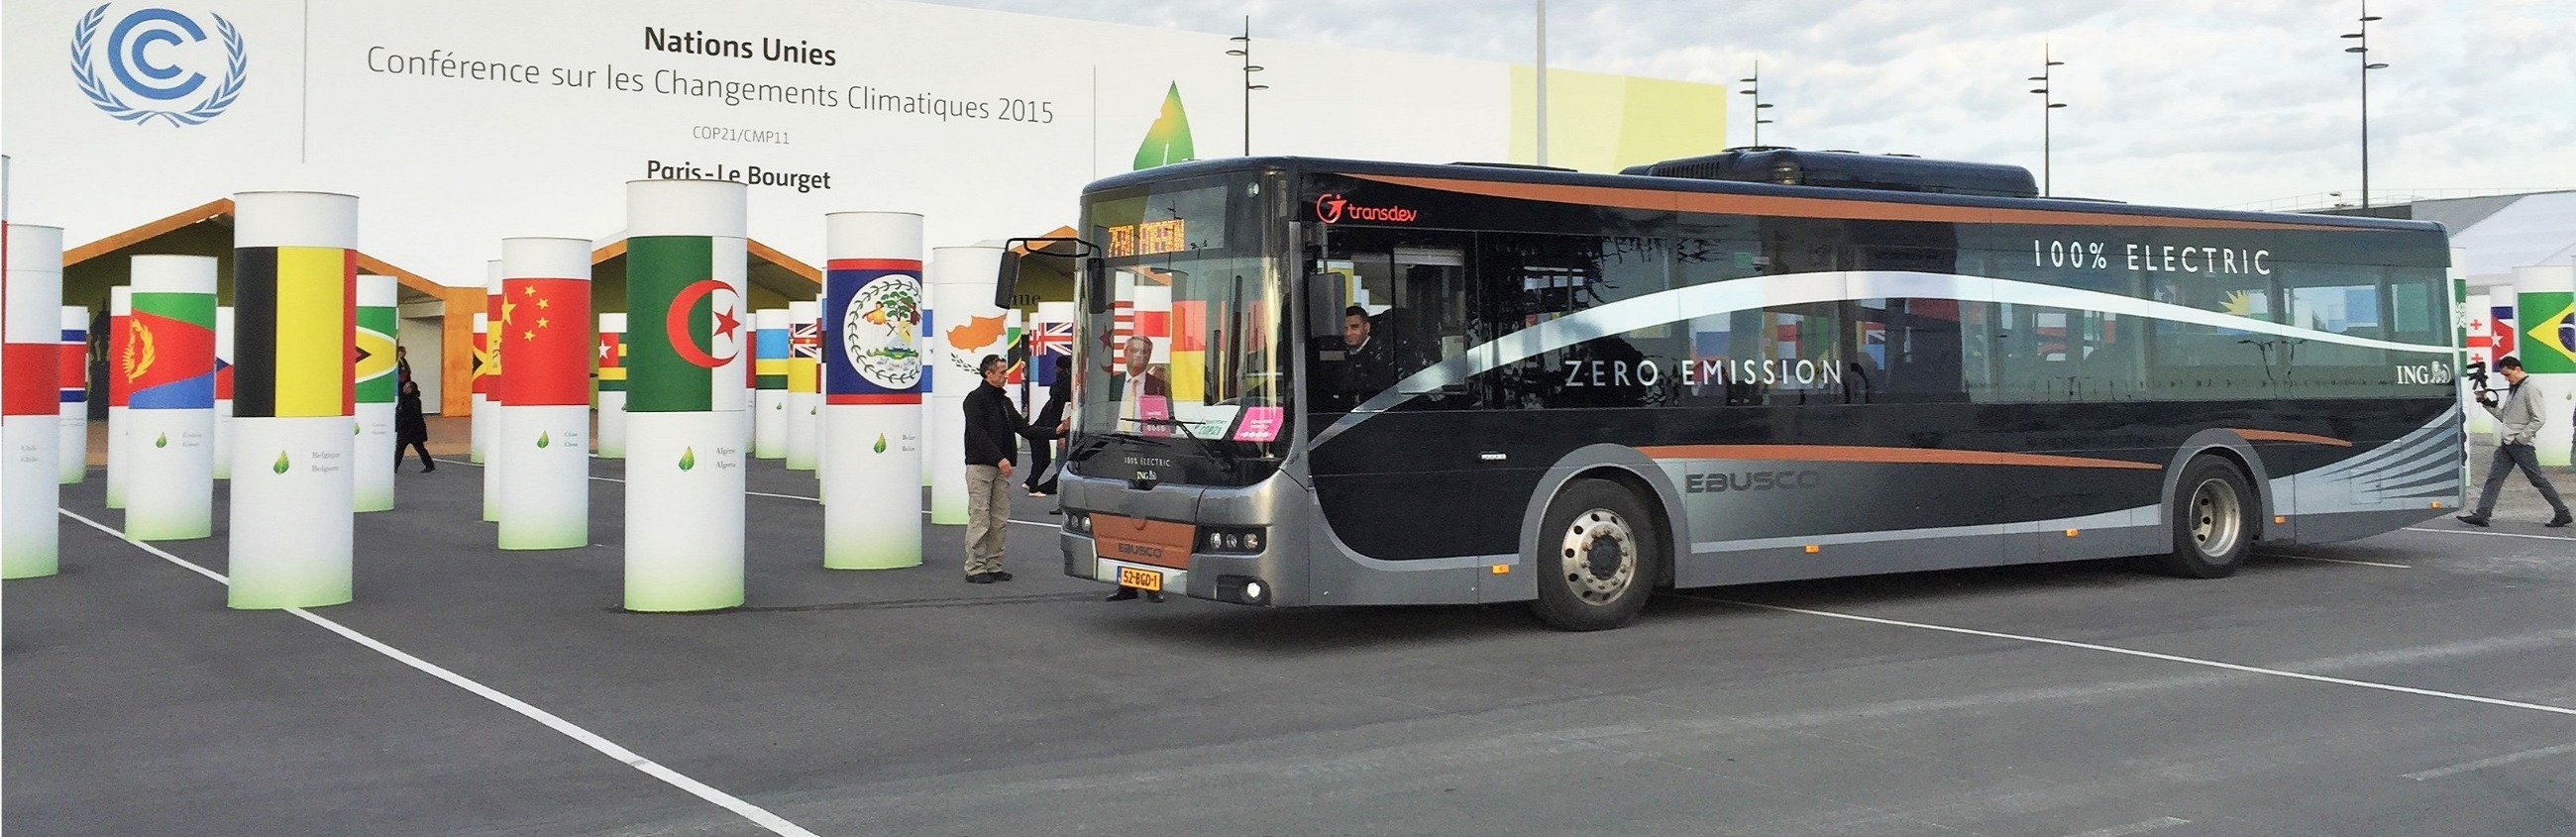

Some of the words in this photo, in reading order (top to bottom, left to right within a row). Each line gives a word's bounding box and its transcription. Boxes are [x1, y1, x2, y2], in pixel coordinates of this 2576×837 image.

[644, 26, 753, 58] Nations
[763, 37, 836, 66] Unies
[368, 46, 540, 84] Conférence
[551, 66, 596, 87] sur
[607, 63, 644, 92] les
[655, 69, 838, 107] Changements
[848, 85, 989, 122] Climatiques
[998, 97, 1053, 124] 2015
[693, 126, 790, 145] COP21/CMP11
[748, 165, 831, 194] Bourget
[1347, 203, 1418, 222] transdev
[2034, 239, 2107, 269] 100%
[2126, 244, 2271, 275] ELECTRIC
[1564, 360, 1659, 386] ZERO
[1682, 359, 1842, 385] EMISSION
[2396, 365, 2429, 384] ING
[1686, 470, 1818, 493] EBUSCO
[1123, 570, 1157, 588] 52-BGD-1
